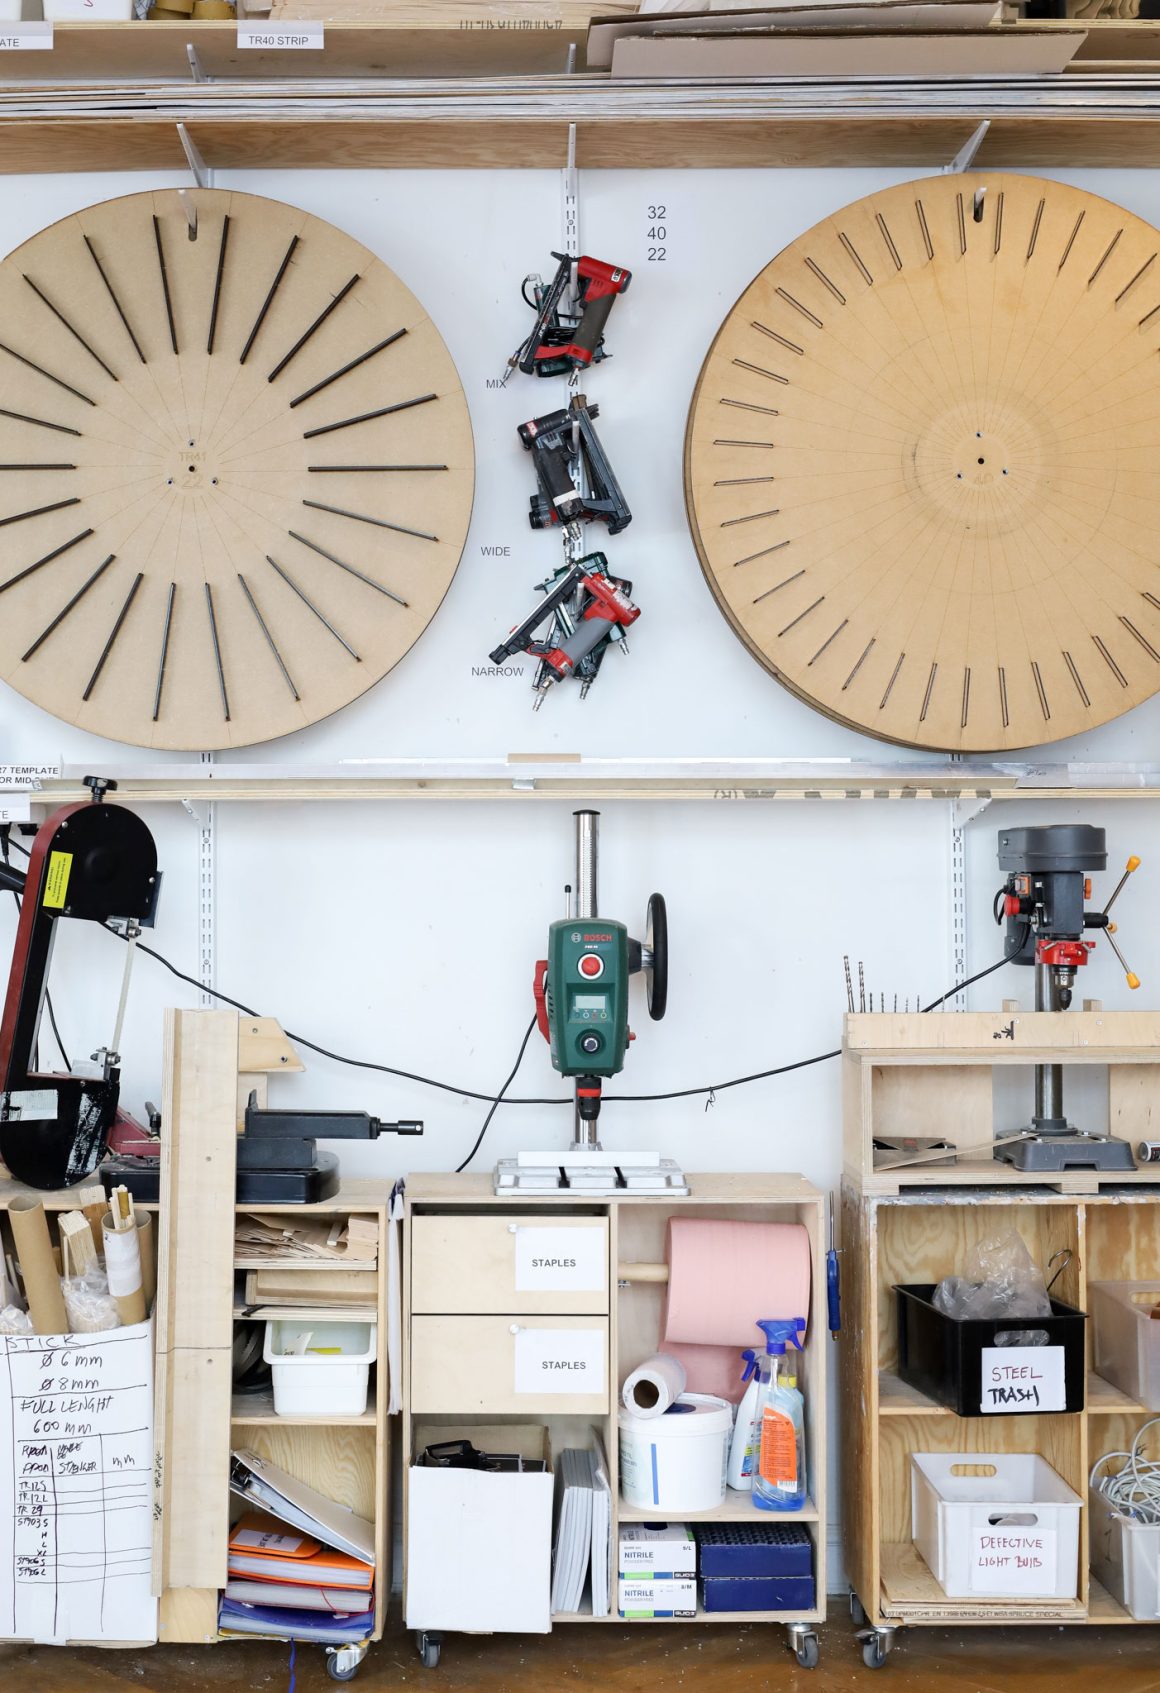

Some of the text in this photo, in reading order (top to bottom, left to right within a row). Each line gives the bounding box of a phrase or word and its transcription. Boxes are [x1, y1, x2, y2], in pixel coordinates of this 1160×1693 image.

[248, 35, 309, 46] TR40 STRIP
[647, 205, 667, 219] 32
[647, 226, 667, 240] 40
[647, 248, 667, 261] 22
[486, 379, 507, 389] MIX
[480, 546, 511, 557] WIDE
[471, 666, 524, 677] NARROW
[10, 766, 59, 774] TEMPLATE
[15, 776, 32, 784] MID
[583, 933, 613, 943] BOSCH
[532, 1258, 577, 1267] STAPLES
[541, 1361, 586, 1370] STAPLES
[991, 1366, 1043, 1382] STEEL
[987, 1385, 1040, 1407] TRASH
[980, 1535, 1043, 1549] DEFECTIVE
[978, 1555, 1011, 1567] LIGHT
